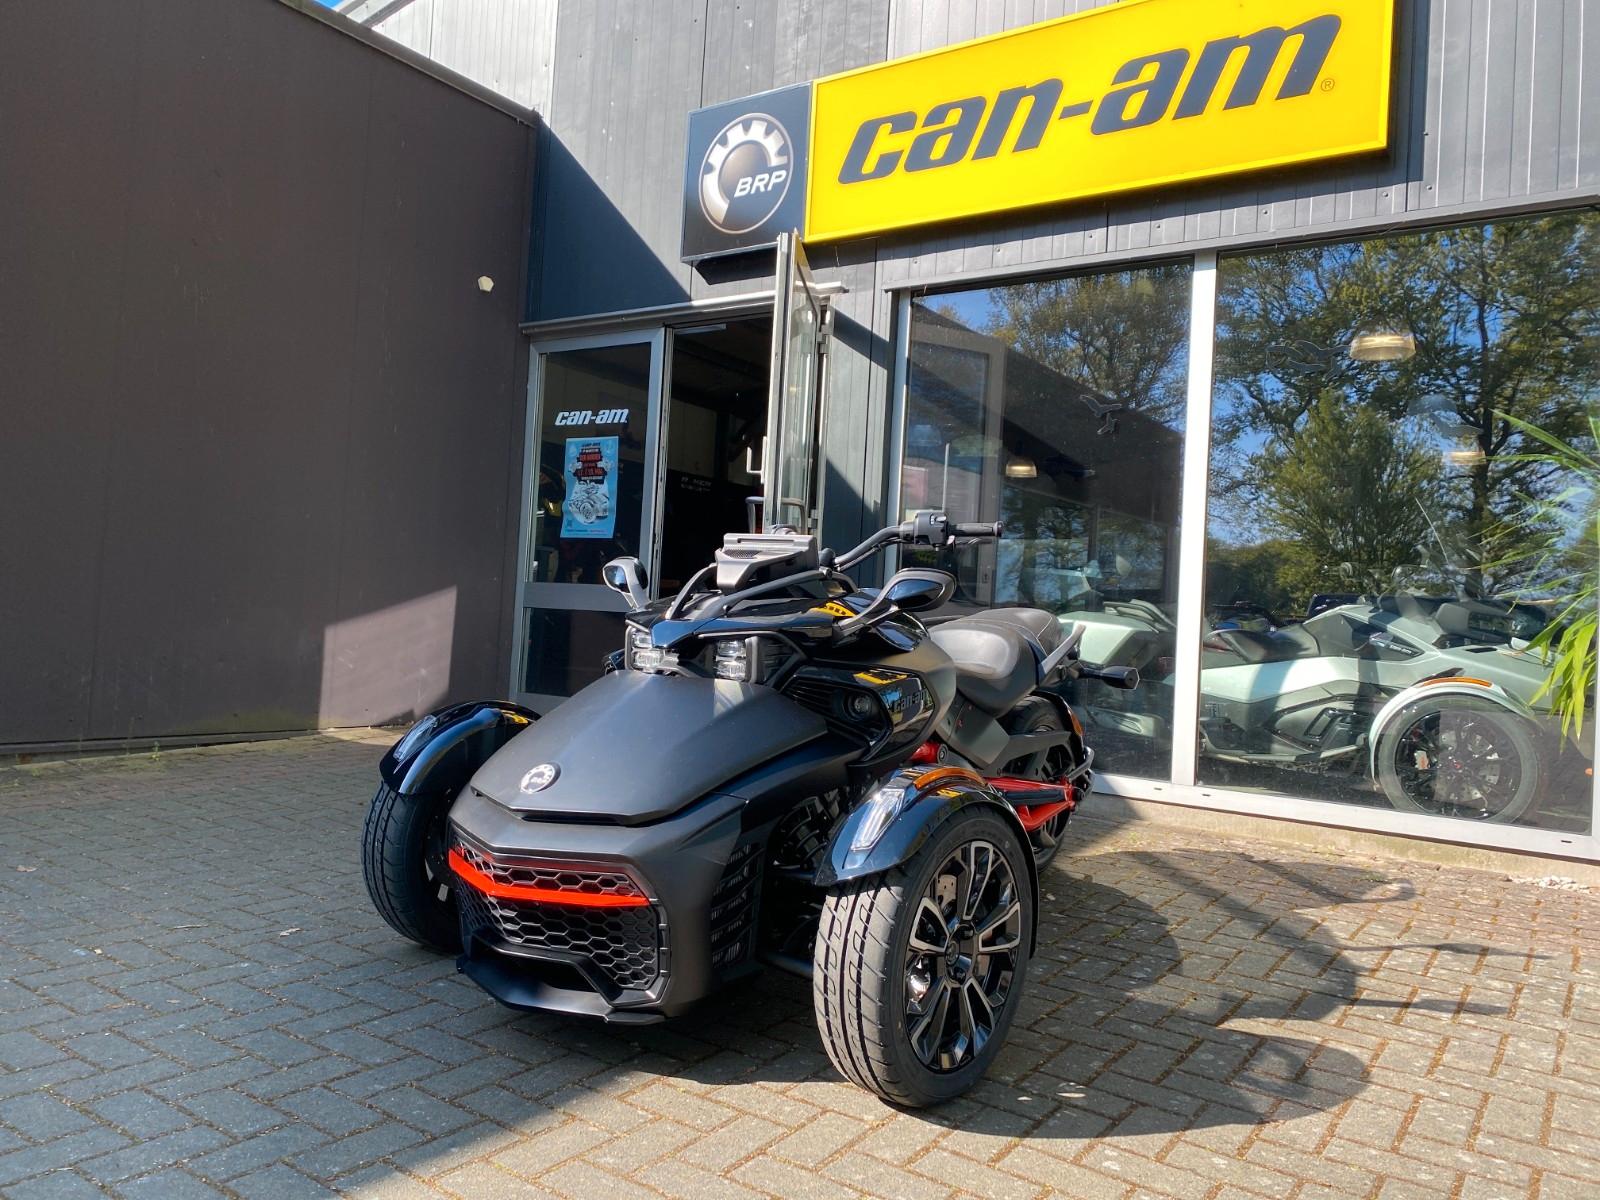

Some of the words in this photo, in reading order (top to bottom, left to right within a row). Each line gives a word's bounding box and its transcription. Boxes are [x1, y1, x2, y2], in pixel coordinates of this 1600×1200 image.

[839, 15, 1341, 184] can-am
[734, 170, 787, 197] BRP
[555, 409, 629, 426] can-am
